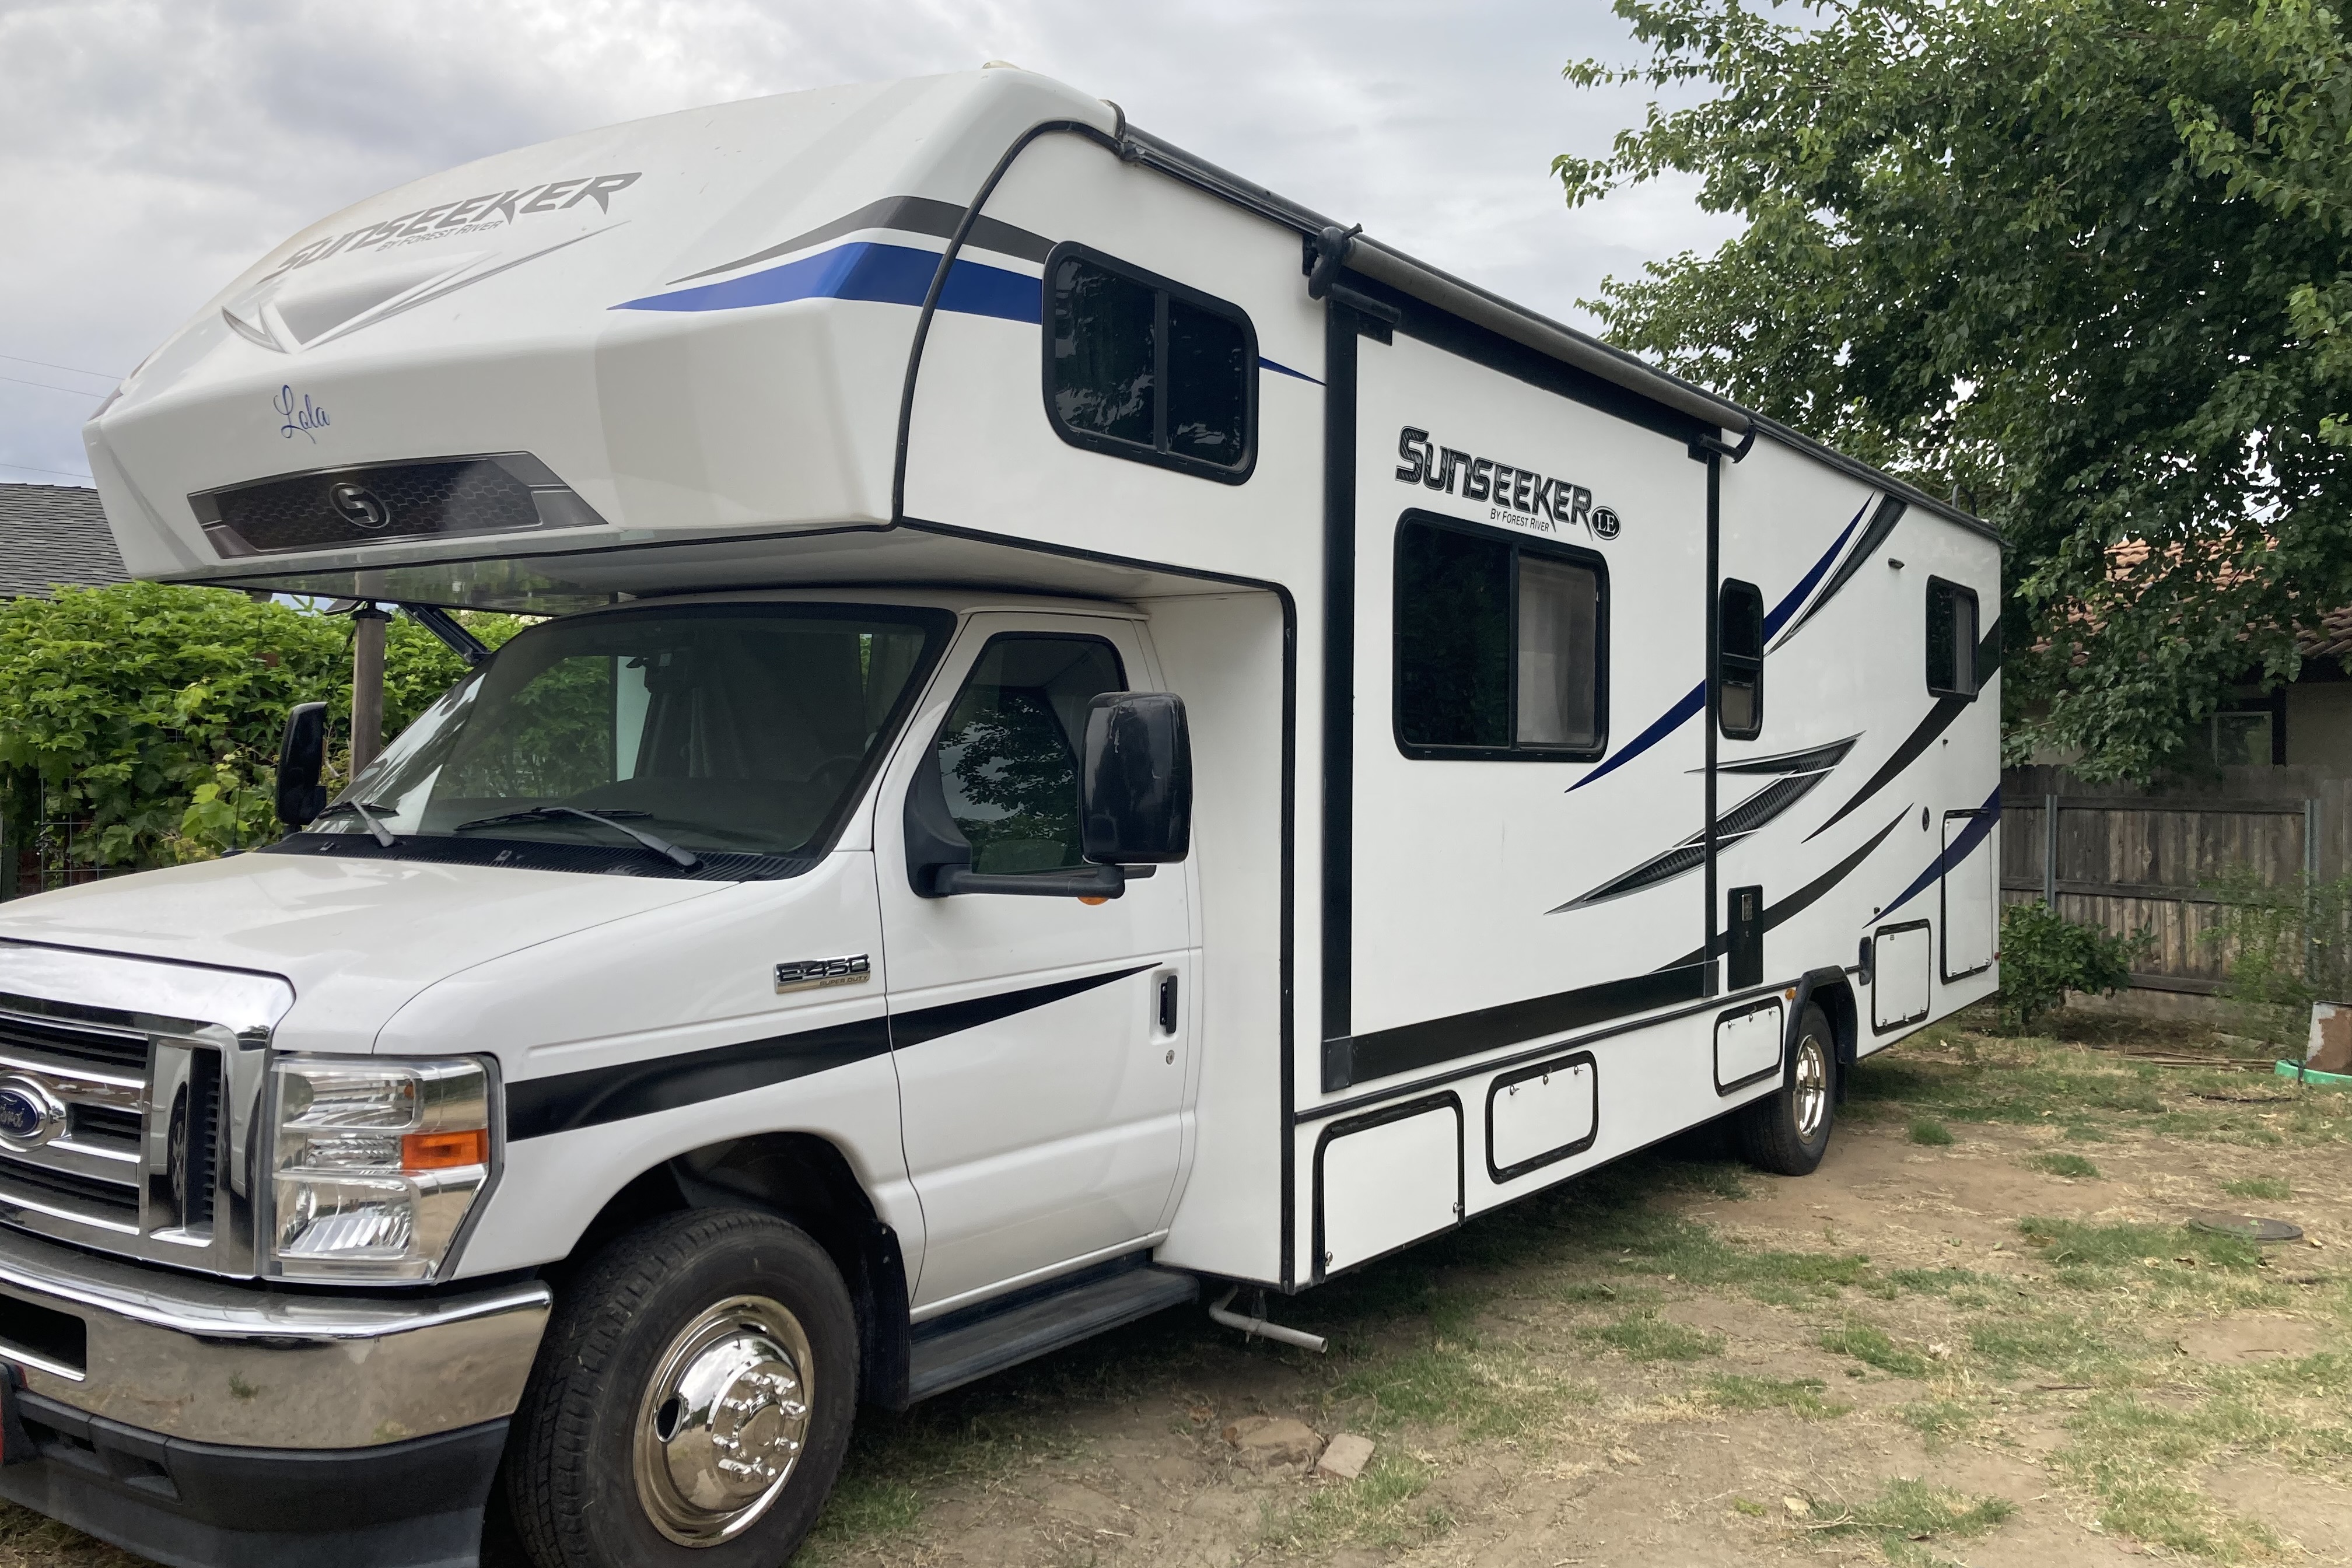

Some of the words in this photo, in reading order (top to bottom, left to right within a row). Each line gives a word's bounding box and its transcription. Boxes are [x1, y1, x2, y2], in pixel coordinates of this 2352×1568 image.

[255, 172, 642, 286] SUNSEEKER
[375, 239, 401, 252] BY
[396, 228, 459, 247] FOREST
[454, 220, 504, 235] RIVER
[274, 384, 330, 444] Lola
[1596, 512, 1616, 534] LE
[820, 978, 845, 986] SUPER
[0, 1095, 25, 1128] ord
